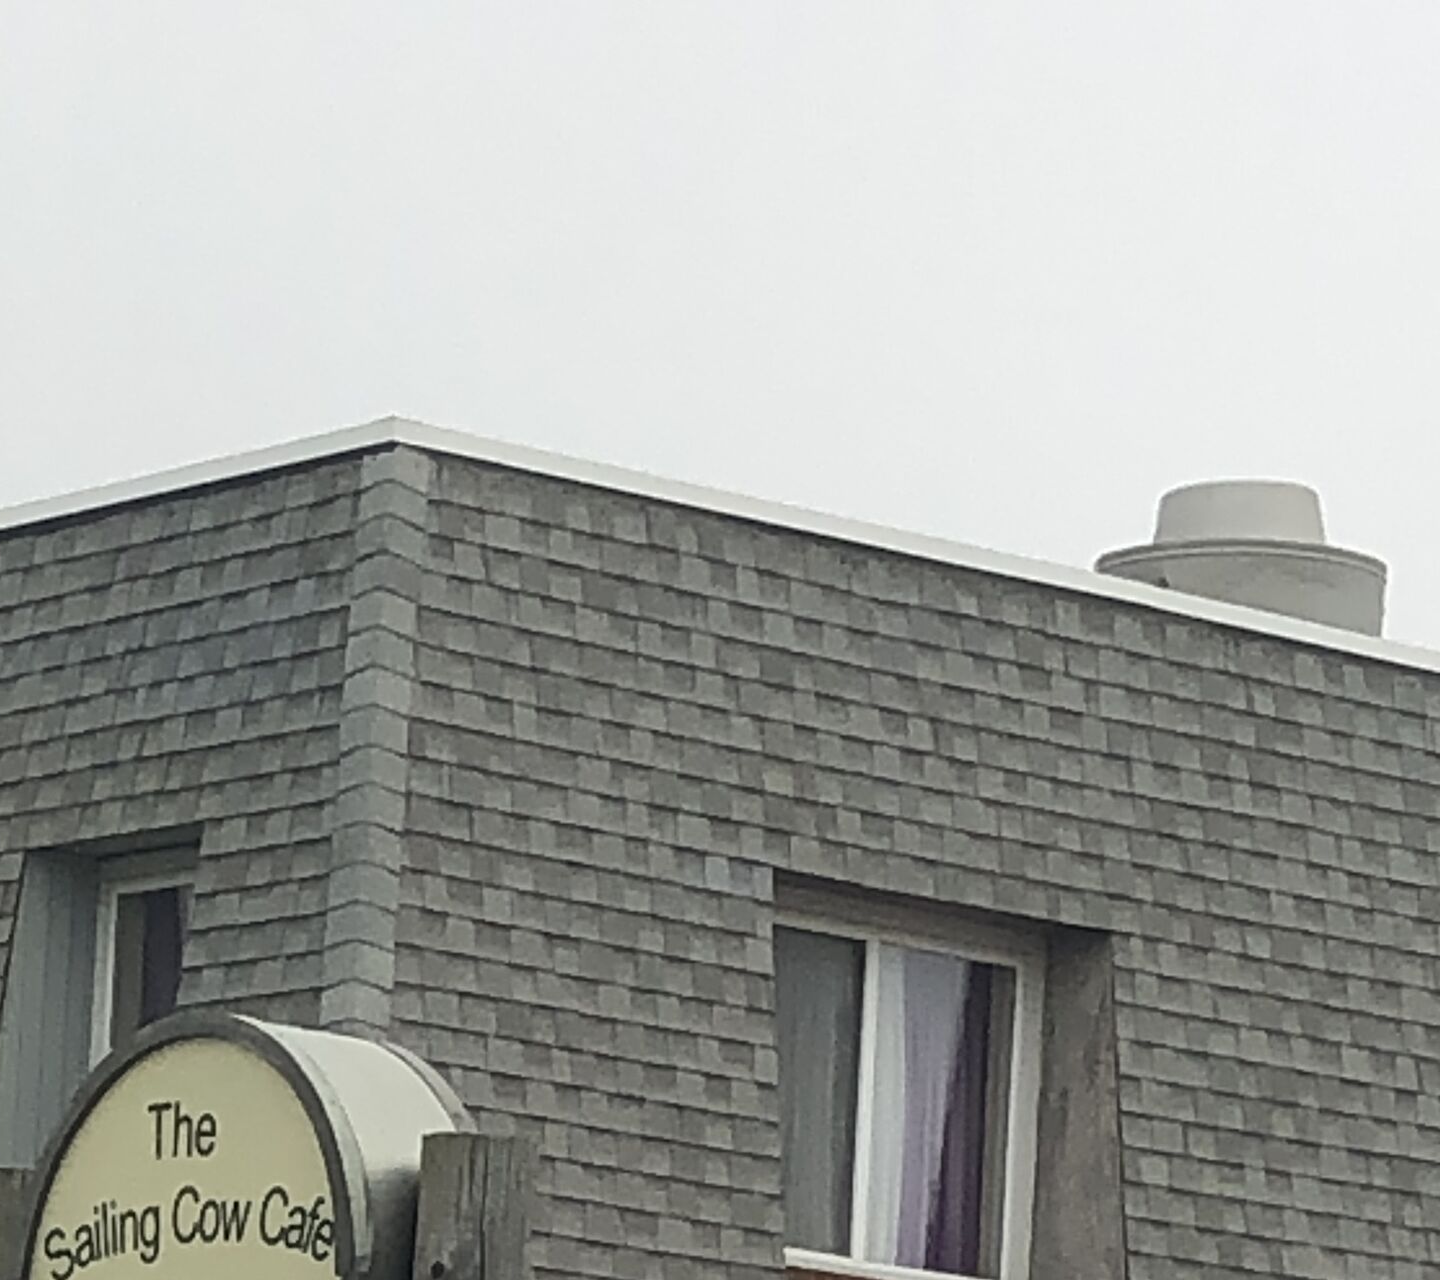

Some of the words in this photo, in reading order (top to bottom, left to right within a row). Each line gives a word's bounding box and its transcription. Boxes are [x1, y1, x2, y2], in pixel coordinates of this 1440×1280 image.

[147, 1101, 217, 1160] The
[172, 1185, 252, 1243] Cow
[259, 1185, 335, 1261] Cafe
